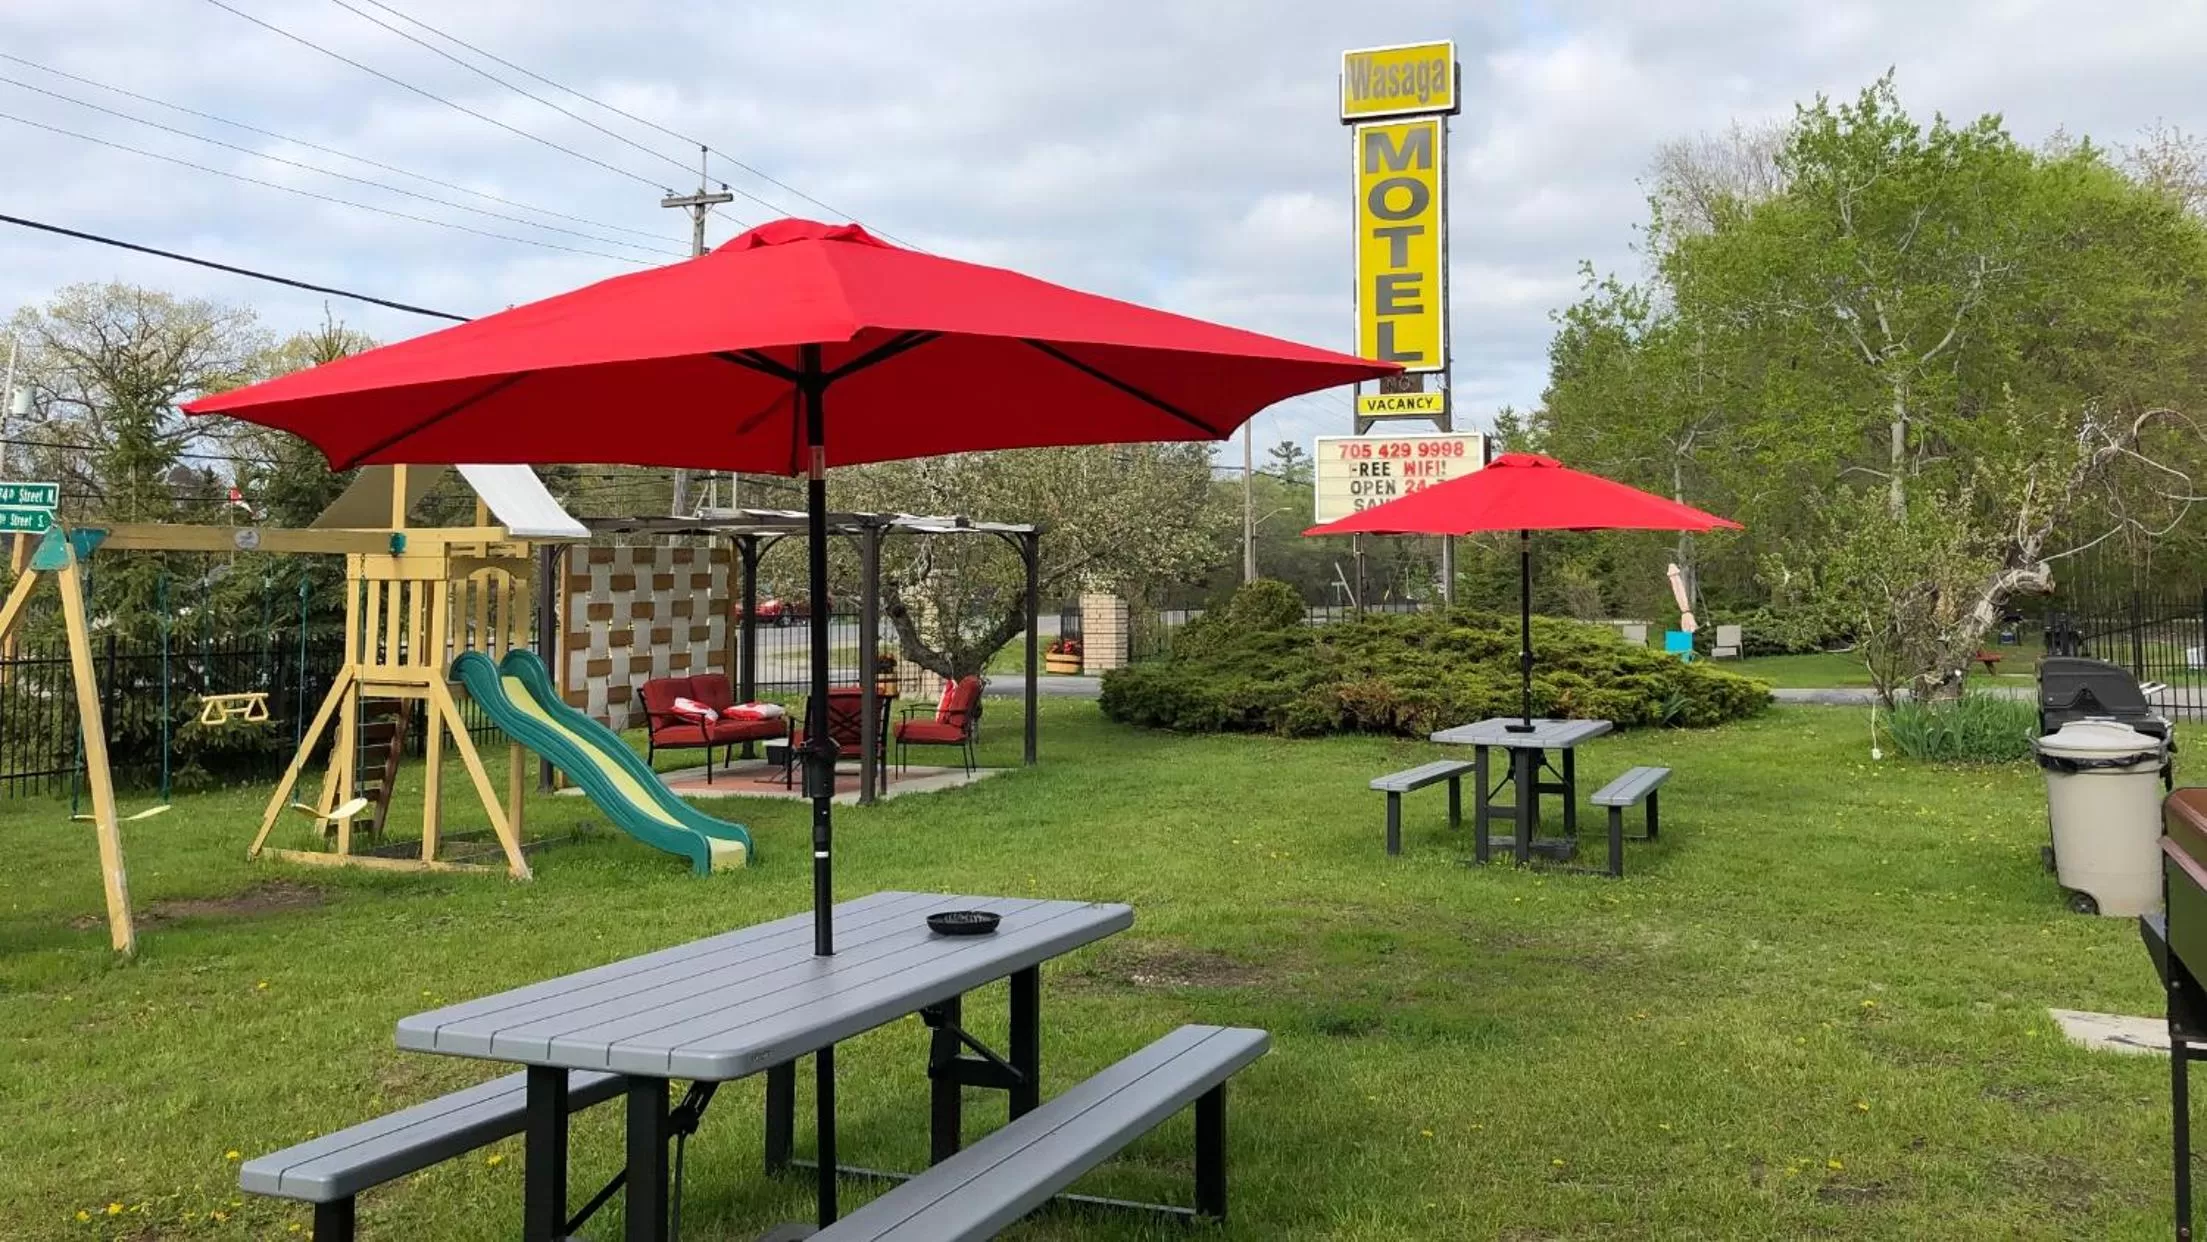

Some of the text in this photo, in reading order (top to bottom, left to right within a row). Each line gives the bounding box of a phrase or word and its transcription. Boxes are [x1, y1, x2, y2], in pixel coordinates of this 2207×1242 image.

[1349, 55, 1446, 104] Wasaga
[1364, 126, 1433, 363] MOTEL
[1367, 397, 1434, 411] VACANCY
[1340, 441, 1465, 459] 705 429 9998
[1403, 460, 1447, 477] WIFI!
[19, 488, 44, 503] Street
[1350, 480, 1396, 496] OPEN
[10, 513, 32, 527] Street
